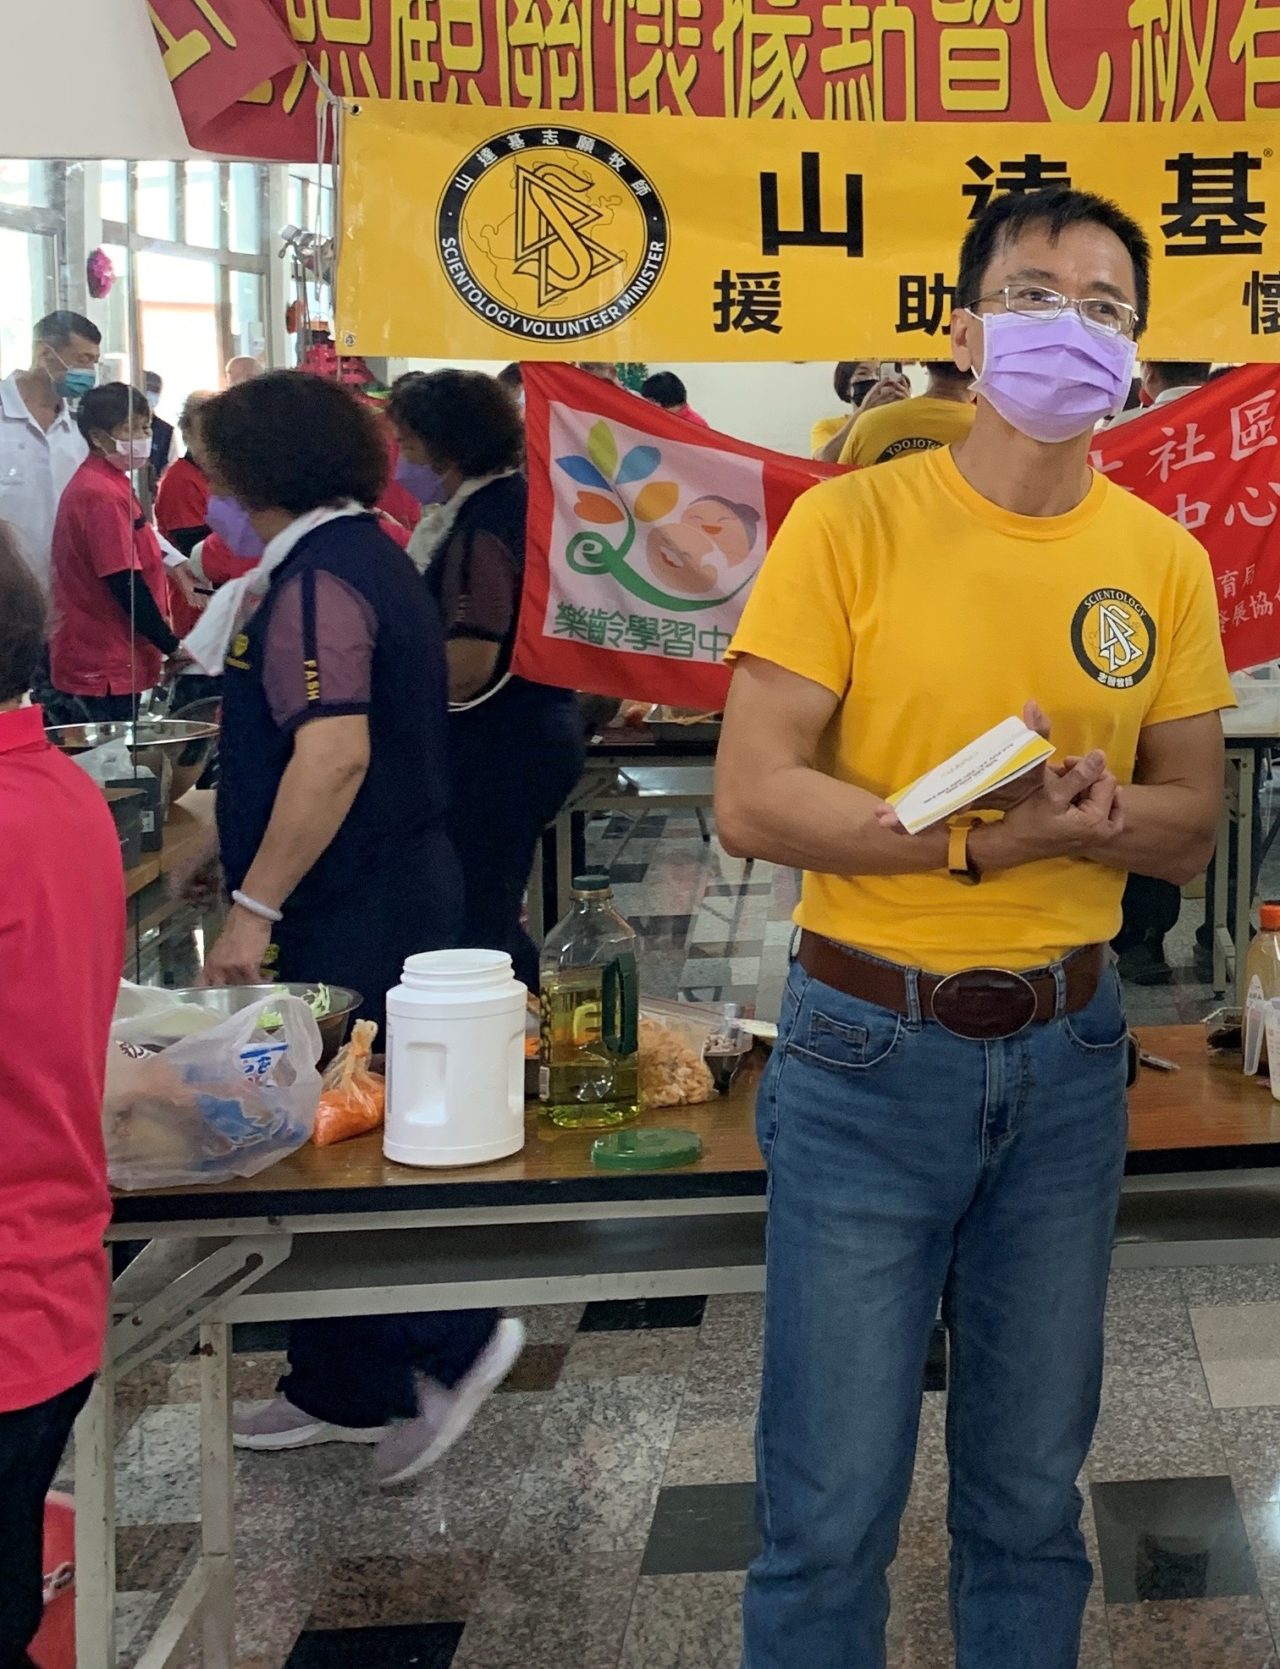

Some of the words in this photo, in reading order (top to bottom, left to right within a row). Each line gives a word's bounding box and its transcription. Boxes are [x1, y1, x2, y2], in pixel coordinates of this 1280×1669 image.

[454, 128, 652, 197] 山達基志願牧師
[441, 236, 523, 329] SCIENTOLOGY
[522, 305, 623, 337] VOLUNTEER
[617, 240, 665, 312] MINISTER
[553, 601, 732, 662] 樂齡學習中
[1083, 590, 1147, 617] SCIENTOLOGY
